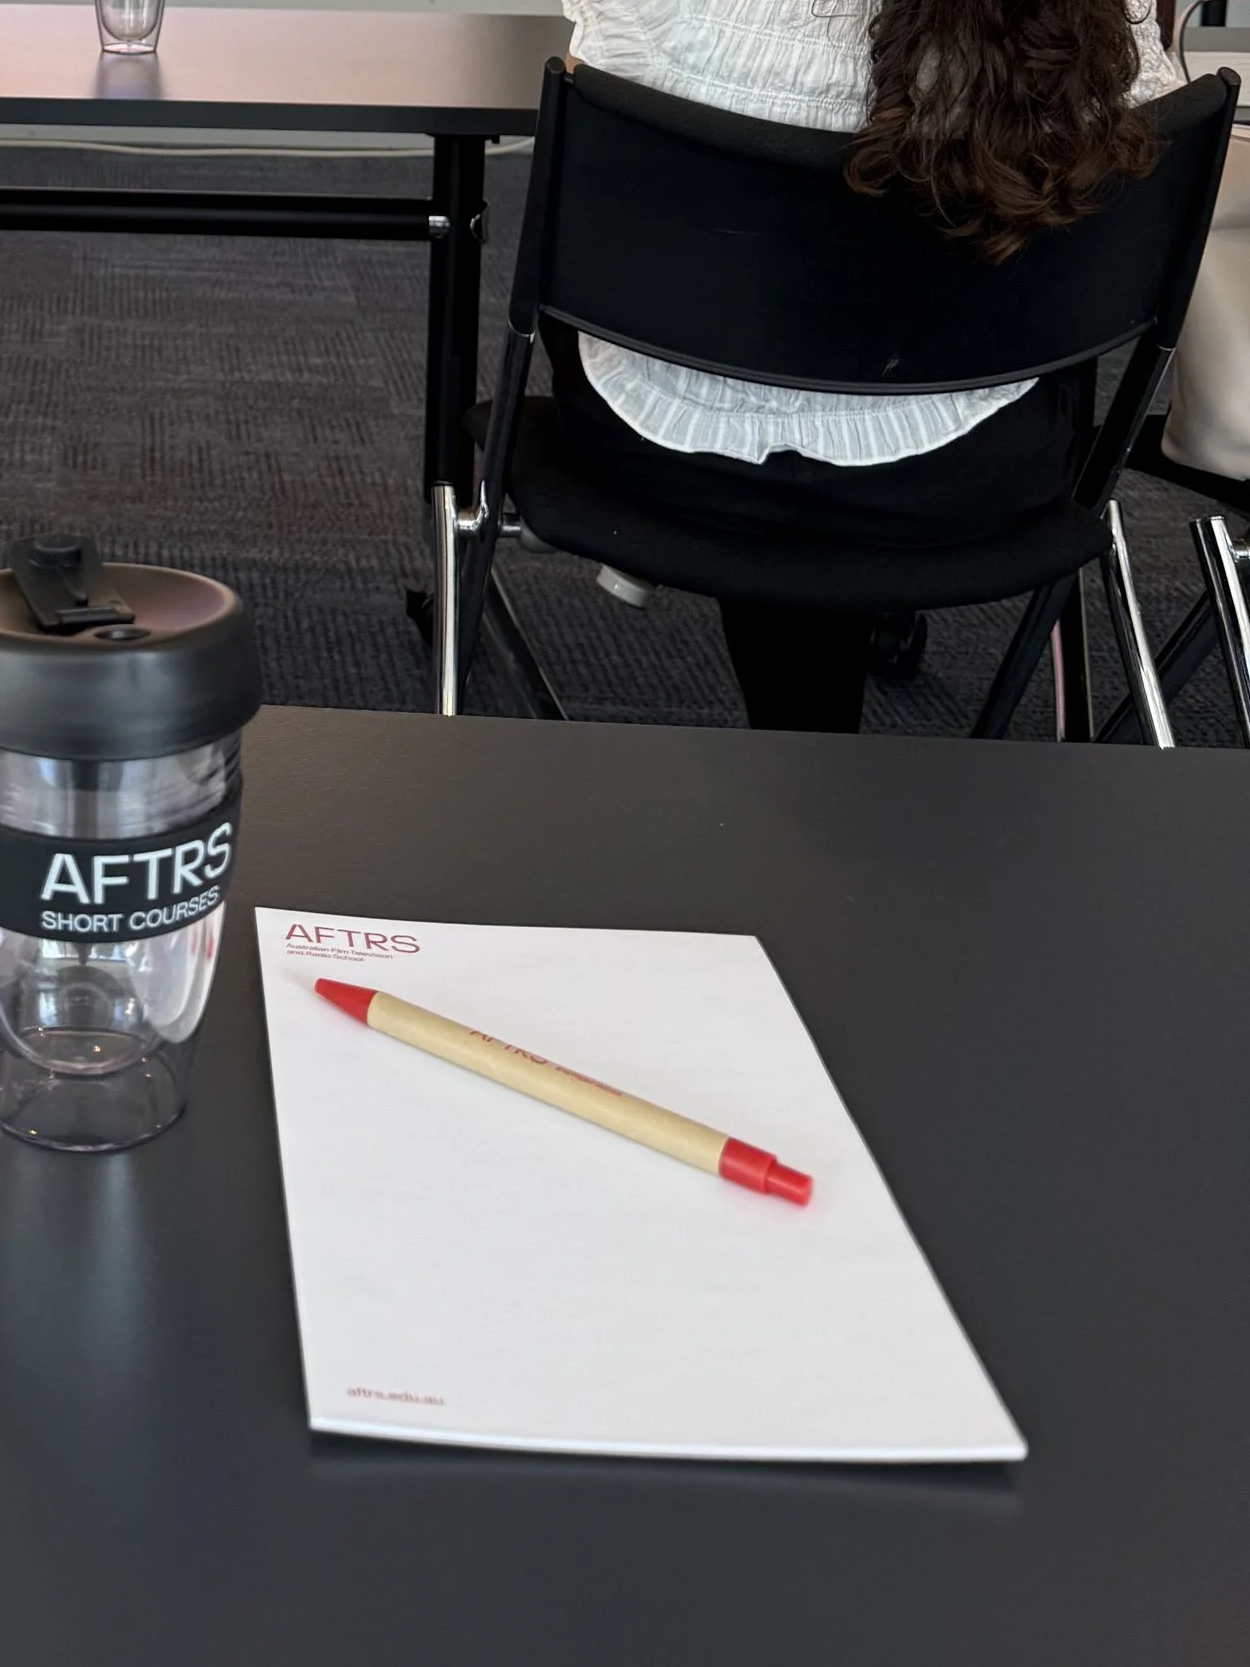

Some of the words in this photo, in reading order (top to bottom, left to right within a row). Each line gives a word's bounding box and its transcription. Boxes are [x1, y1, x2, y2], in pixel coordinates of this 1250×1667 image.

[40, 821, 234, 905] AFTRS
[41, 910, 126, 933] SHORT
[129, 885, 221, 931] COURSES
[285, 924, 421, 954] AFTRS
